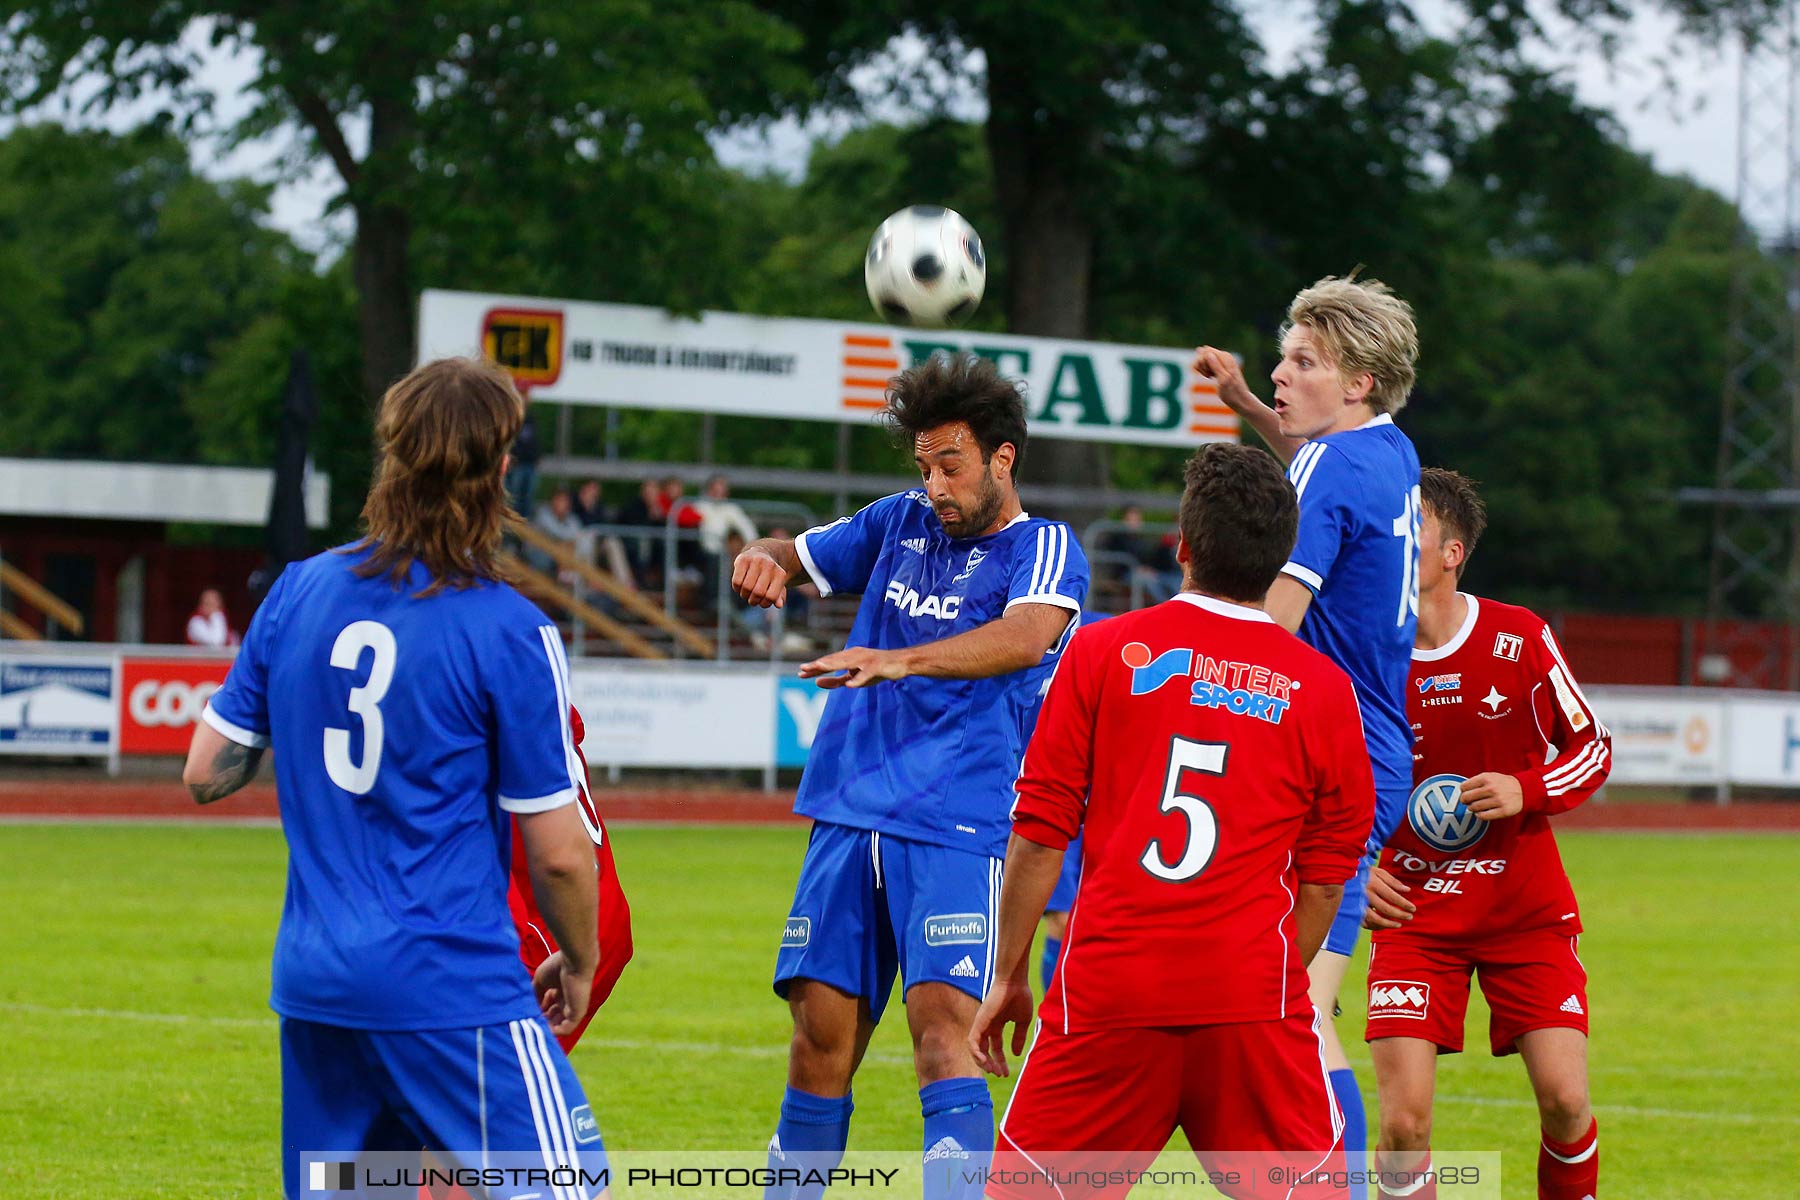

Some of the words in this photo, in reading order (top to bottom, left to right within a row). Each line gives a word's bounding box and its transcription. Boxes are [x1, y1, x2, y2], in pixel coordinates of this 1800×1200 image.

[1495, 634, 1521, 660] FT
[1193, 653, 1292, 700] INTER
[1434, 681, 1461, 692] SPORT
[322, 619, 397, 796] 3
[1190, 680, 1290, 725] SPORT
[1139, 733, 1231, 884] 5
[1392, 849, 1507, 875] TOVEKS
[1423, 877, 1464, 895] BIL
[929, 921, 982, 938] Furhoffs
[949, 967, 980, 978] adidas
[1559, 1004, 1584, 1015] adidas
[923, 1148, 969, 1164] adidas
